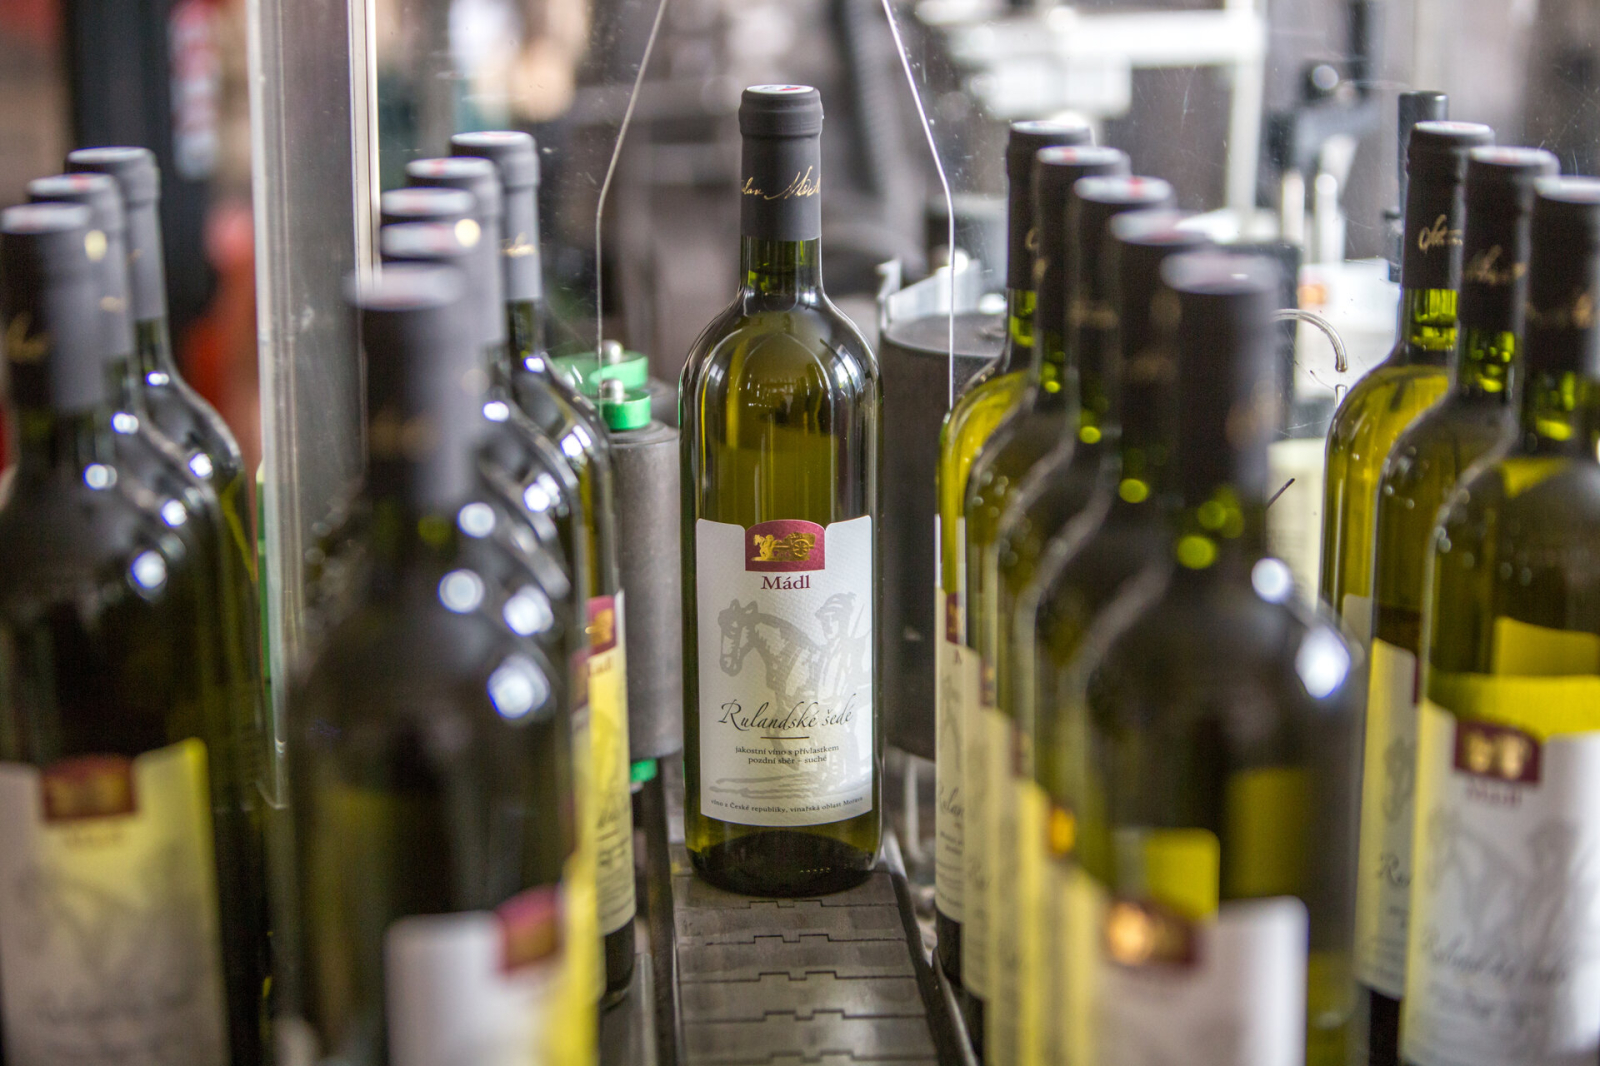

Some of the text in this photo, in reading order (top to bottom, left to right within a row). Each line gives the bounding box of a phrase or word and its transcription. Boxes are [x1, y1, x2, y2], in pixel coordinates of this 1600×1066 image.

[760, 575, 811, 590] Mádl
[717, 693, 857, 732] Rulandské šedé
[735, 745, 767, 755] jakostní
[768, 746, 787, 755] víno
[794, 744, 840, 757] přívlastkem
[748, 756, 776, 765] pozdní
[777, 756, 796, 764] sběr
[804, 754, 828, 764] suché
[729, 801, 750, 811] České
